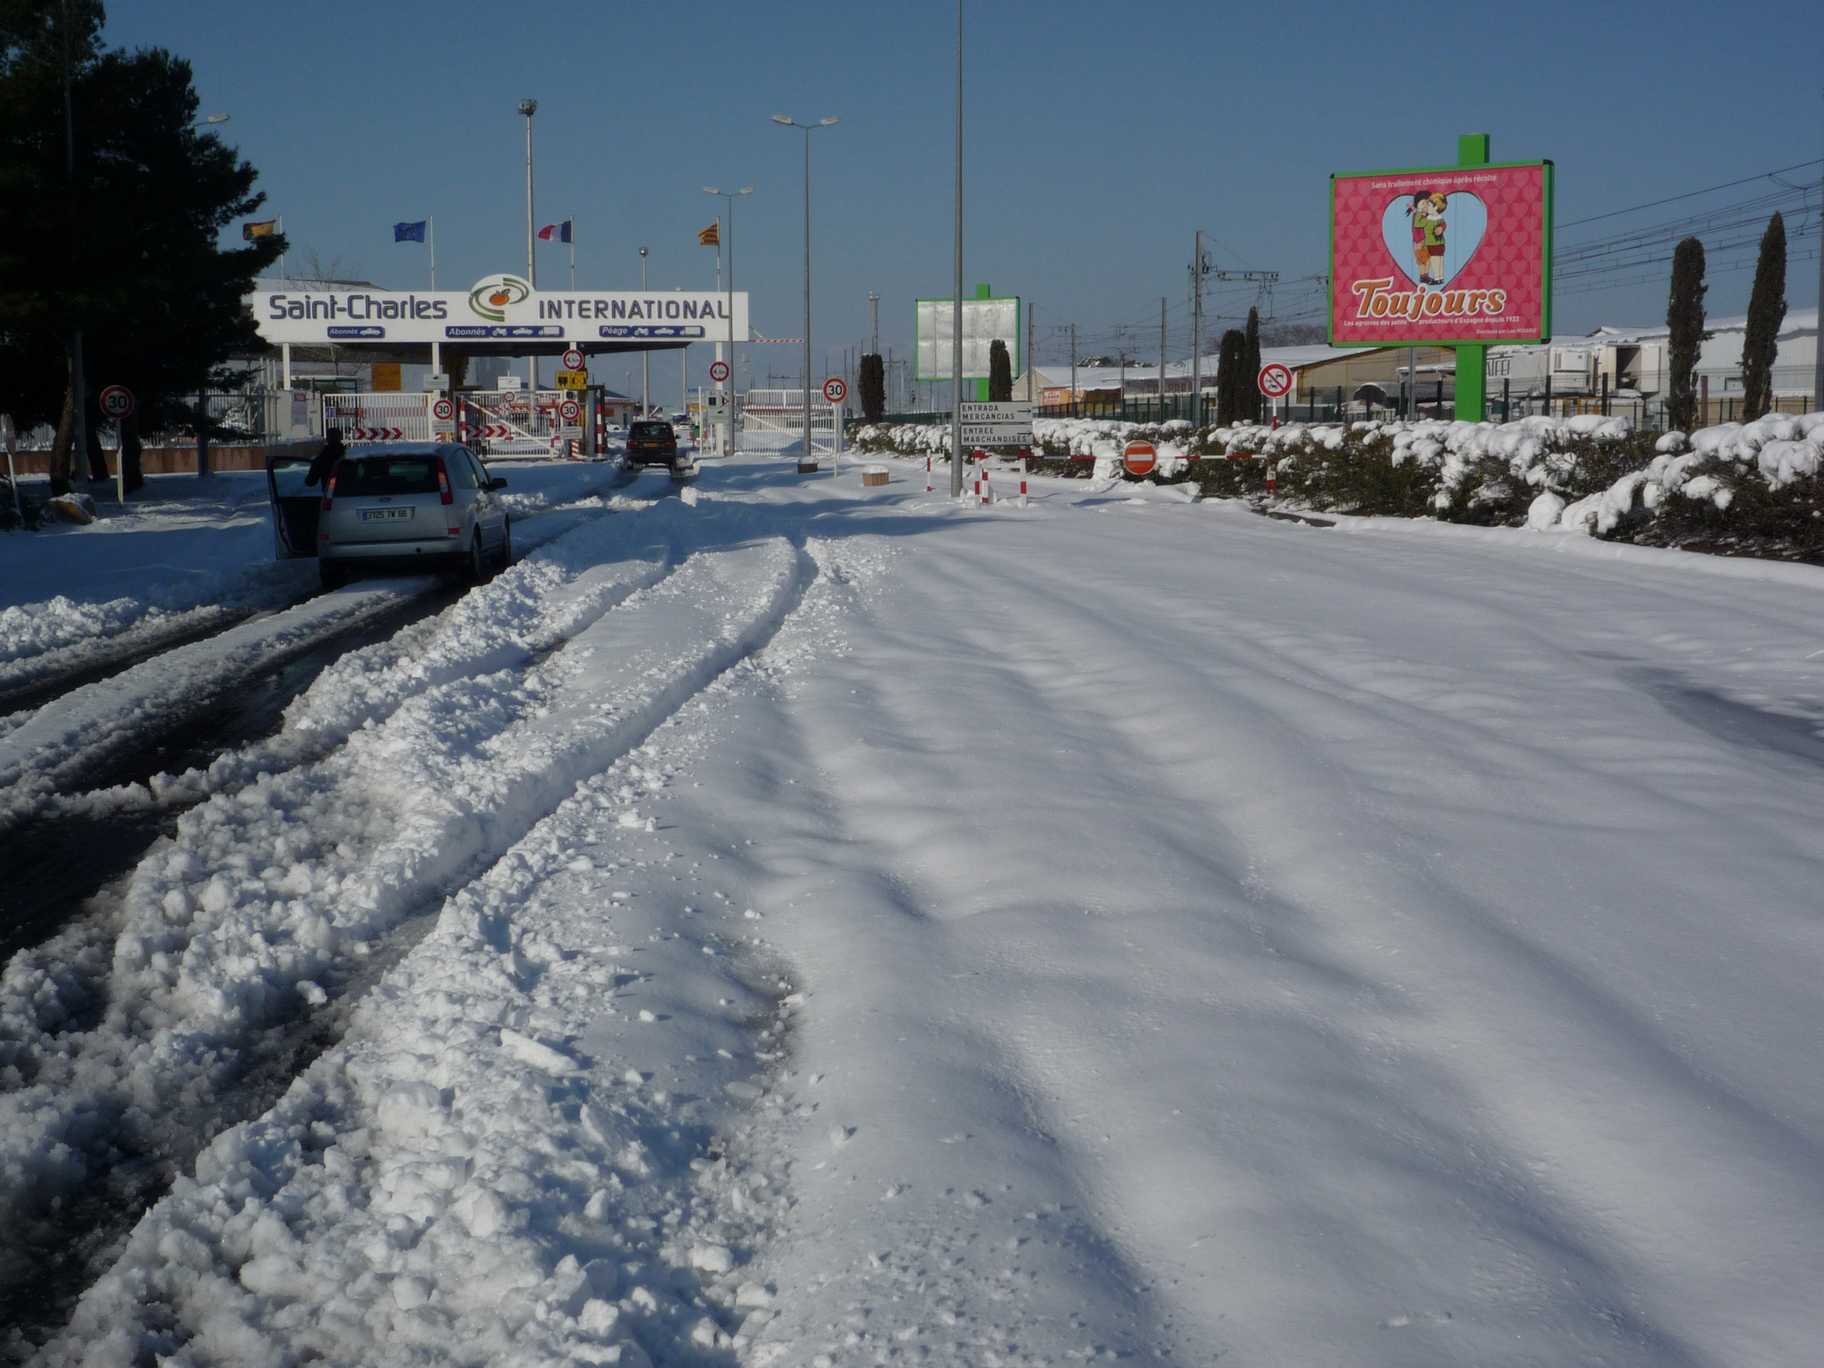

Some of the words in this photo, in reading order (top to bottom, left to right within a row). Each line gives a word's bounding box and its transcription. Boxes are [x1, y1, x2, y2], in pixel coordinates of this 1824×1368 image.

[1352, 276, 1507, 322] Toujours
[269, 294, 448, 320] Saint-Charles
[539, 300, 730, 319] INTERNATIONAL
[449, 327, 486, 336] Abonnés
[602, 326, 628, 337] Péage
[829, 384, 843, 396] 30
[108, 395, 128, 409] 30
[438, 405, 450, 415] 30
[564, 406, 576, 415] 30
